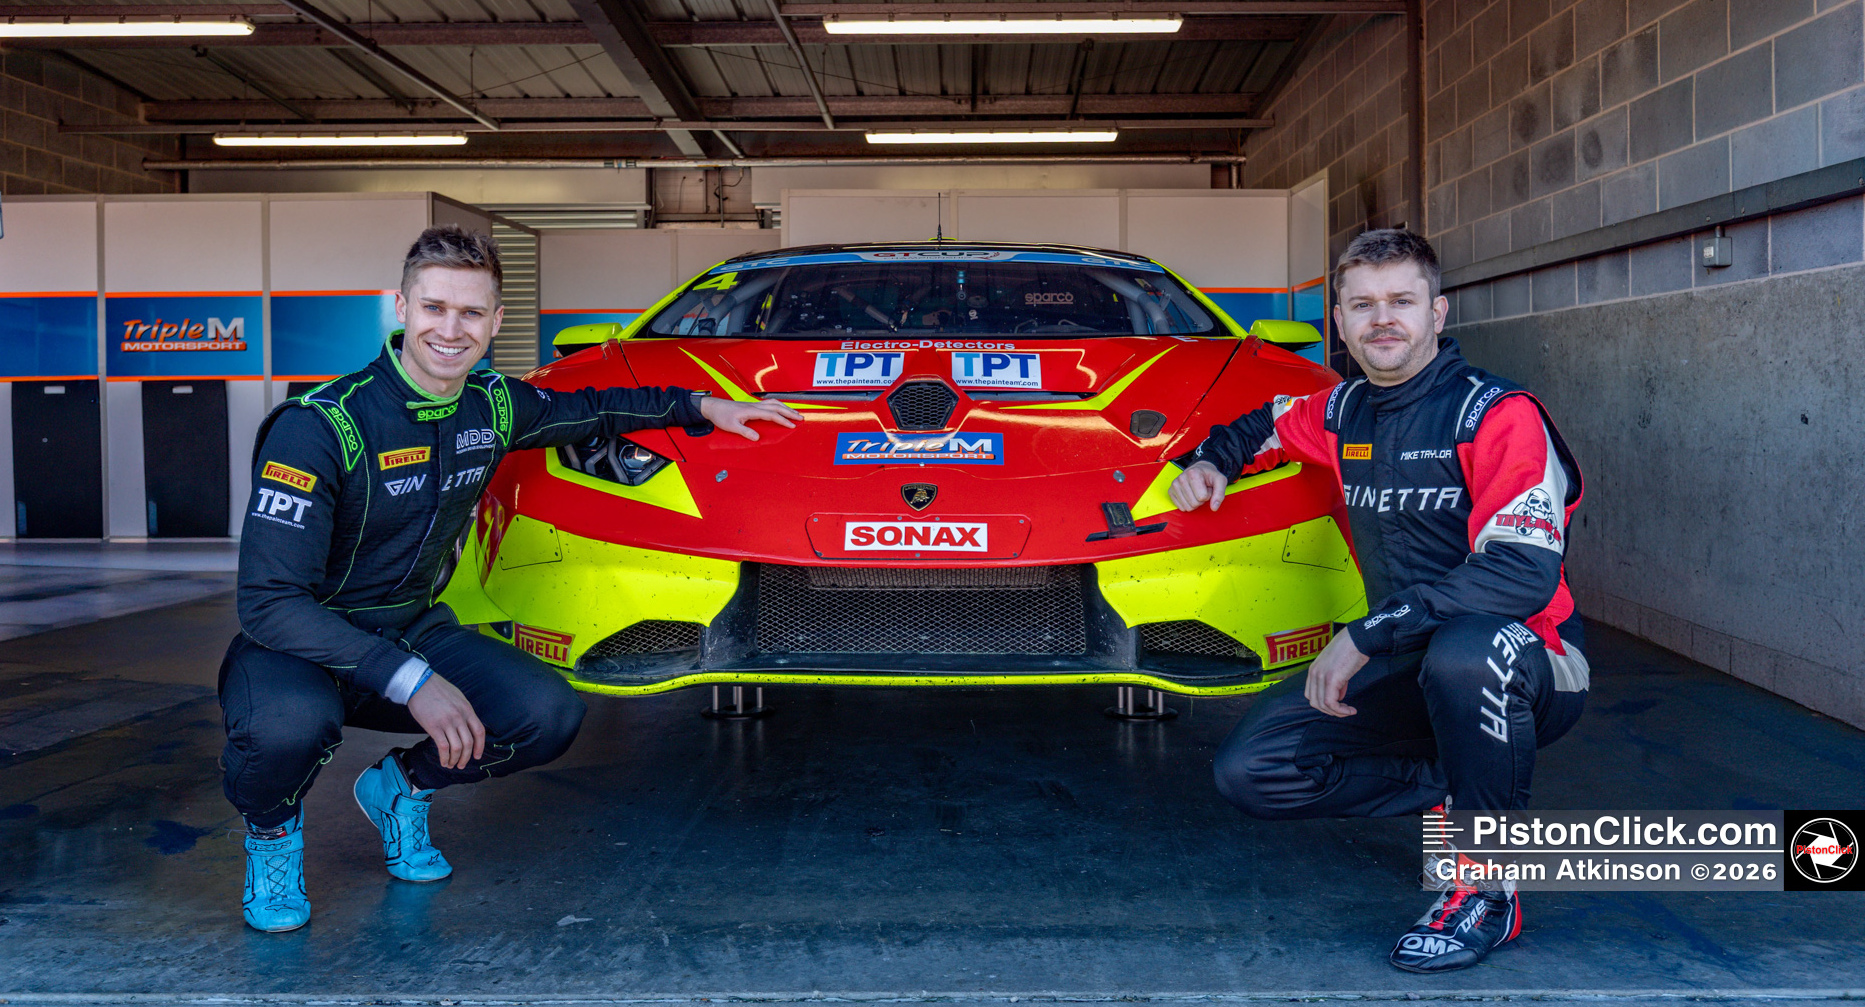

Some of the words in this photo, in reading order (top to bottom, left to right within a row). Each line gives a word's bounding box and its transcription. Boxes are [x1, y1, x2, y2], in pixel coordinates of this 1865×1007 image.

[692, 271, 739, 291] 4
[1025, 291, 1074, 304] sparco
[124, 341, 243, 351] MOTORSPORT
[840, 340, 1016, 351] Electro-Detectors
[819, 352, 902, 377] TPT
[954, 352, 1037, 379] TPT
[956, 378, 1039, 387] www.thepainteam.com
[493, 387, 509, 432] sparco
[1465, 387, 1504, 431] sparco
[328, 406, 359, 453] sparco
[456, 428, 495, 450] MDD
[384, 449, 426, 467] PIRELLI
[1345, 446, 1370, 458] PIRELLI
[1400, 451, 1418, 461] MIKE
[1420, 449, 1453, 459] TAYLOR
[265, 464, 312, 489] PIRELLI
[257, 487, 313, 523] TPT
[251, 512, 306, 530] www.thepainteam.com
[850, 526, 982, 548] SONAX
[1363, 604, 1412, 630] sparco
[514, 622, 573, 663] PIRELLI
[1265, 623, 1332, 664] PIRELLI
